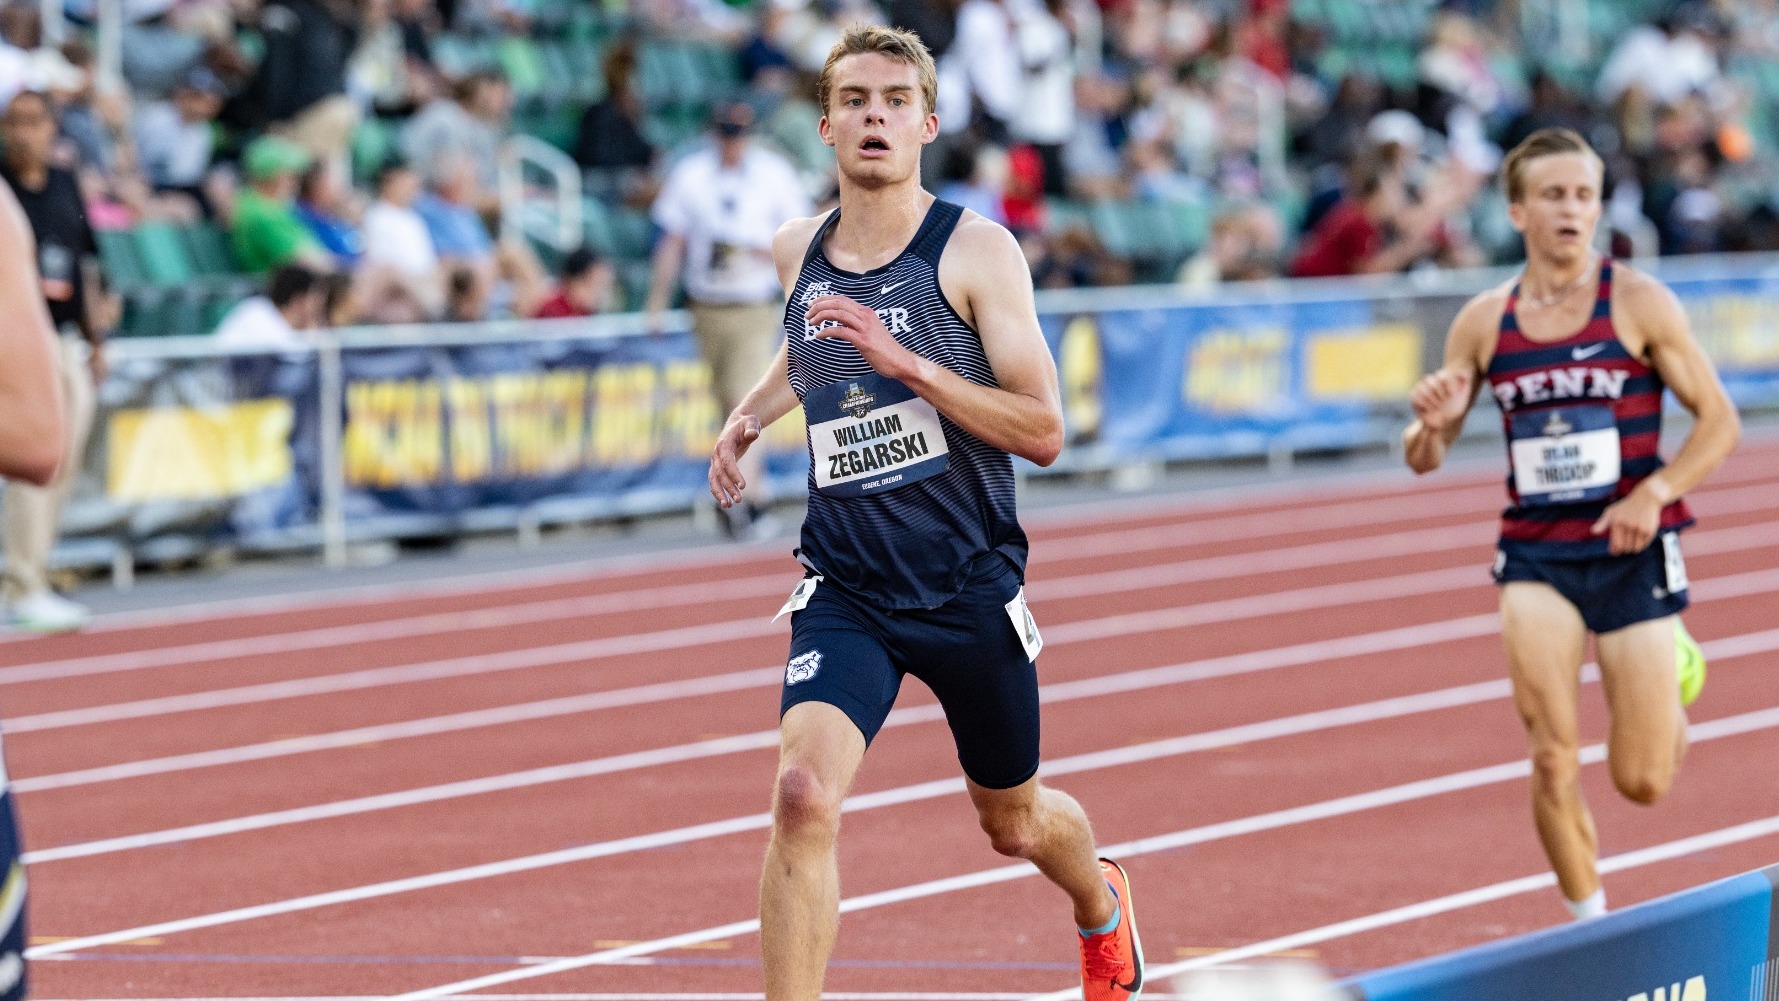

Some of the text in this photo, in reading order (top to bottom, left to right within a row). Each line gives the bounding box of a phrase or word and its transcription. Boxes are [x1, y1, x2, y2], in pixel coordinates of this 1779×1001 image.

[806, 281, 832, 292] BIG
[1494, 367, 1631, 411] PENN
[833, 414, 903, 447] WILLIAM
[828, 431, 929, 480] ZEGARSKI
